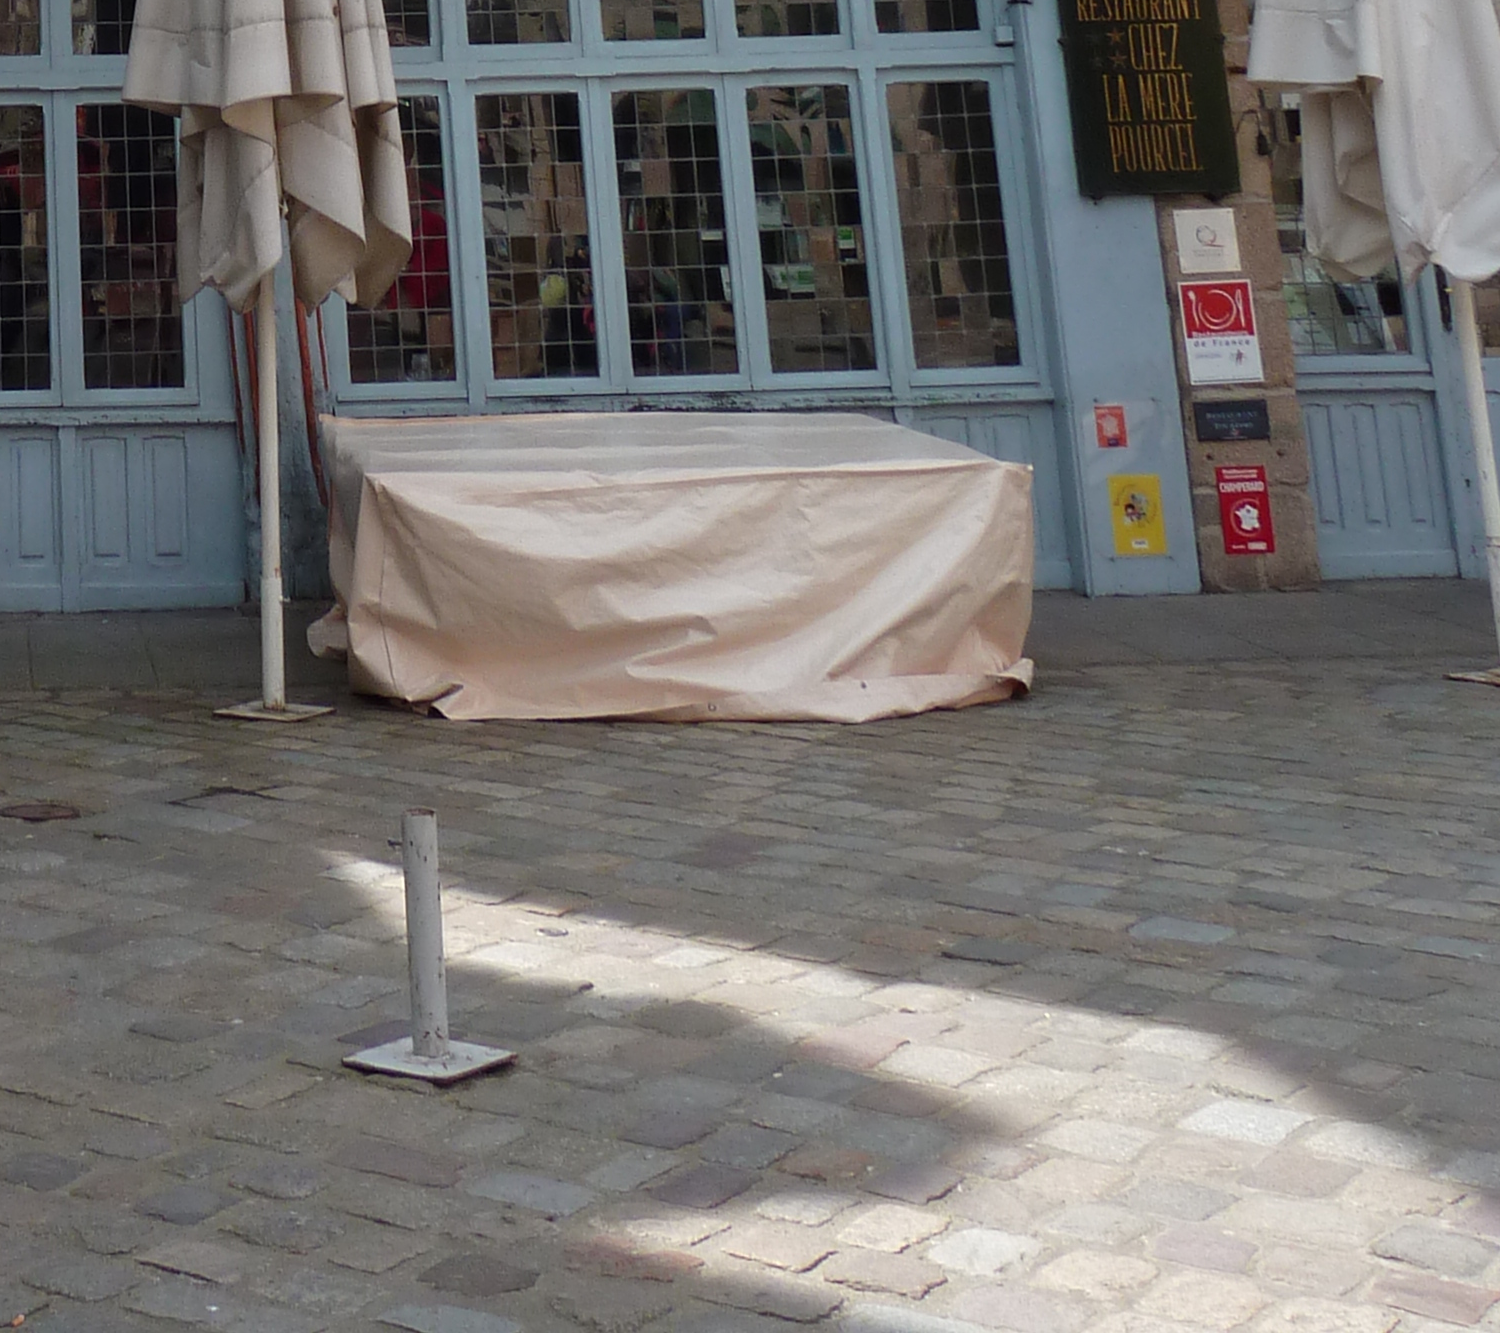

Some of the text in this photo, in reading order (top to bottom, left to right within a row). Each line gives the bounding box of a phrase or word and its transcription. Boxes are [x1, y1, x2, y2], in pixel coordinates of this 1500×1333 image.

[1128, 23, 1183, 70] CHEZ
[1103, 73, 1198, 121] LA MERE
[1108, 123, 1204, 172] POURCEL
